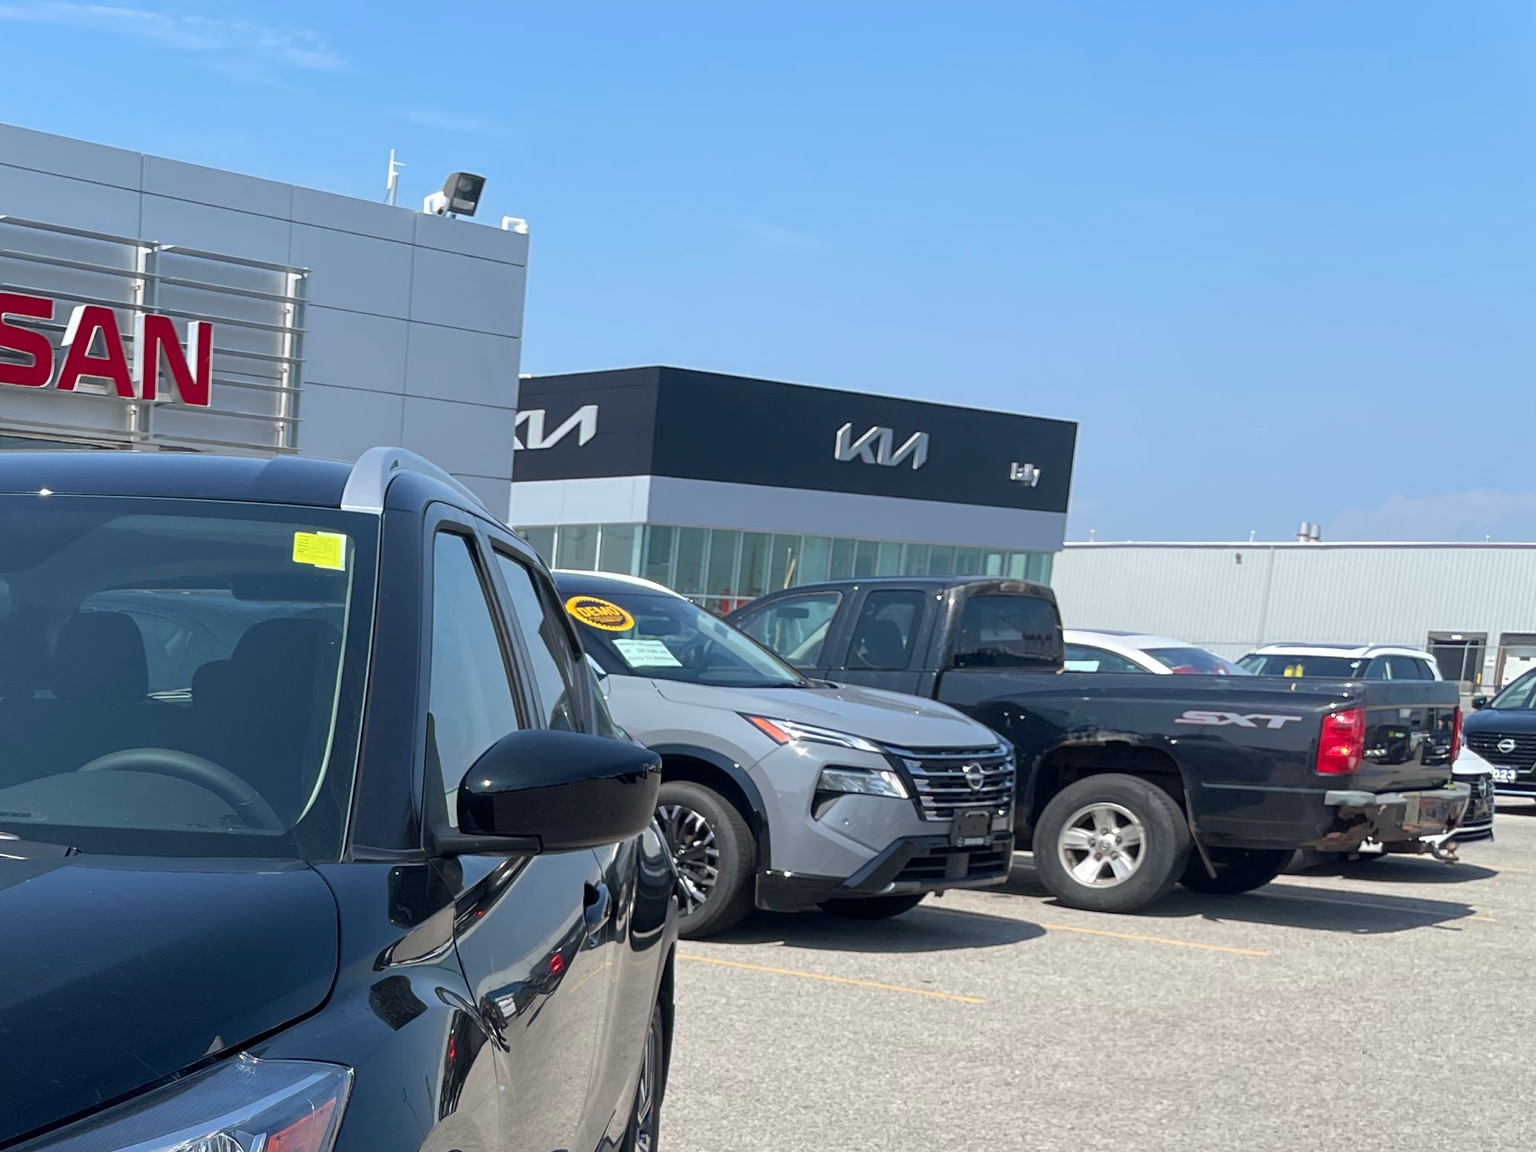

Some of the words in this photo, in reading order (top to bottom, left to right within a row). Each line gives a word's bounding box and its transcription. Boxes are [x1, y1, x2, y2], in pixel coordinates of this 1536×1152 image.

[834, 422, 930, 470] KIA
[576, 605, 621, 618] DEMO
[1174, 710, 1302, 729] SXT
